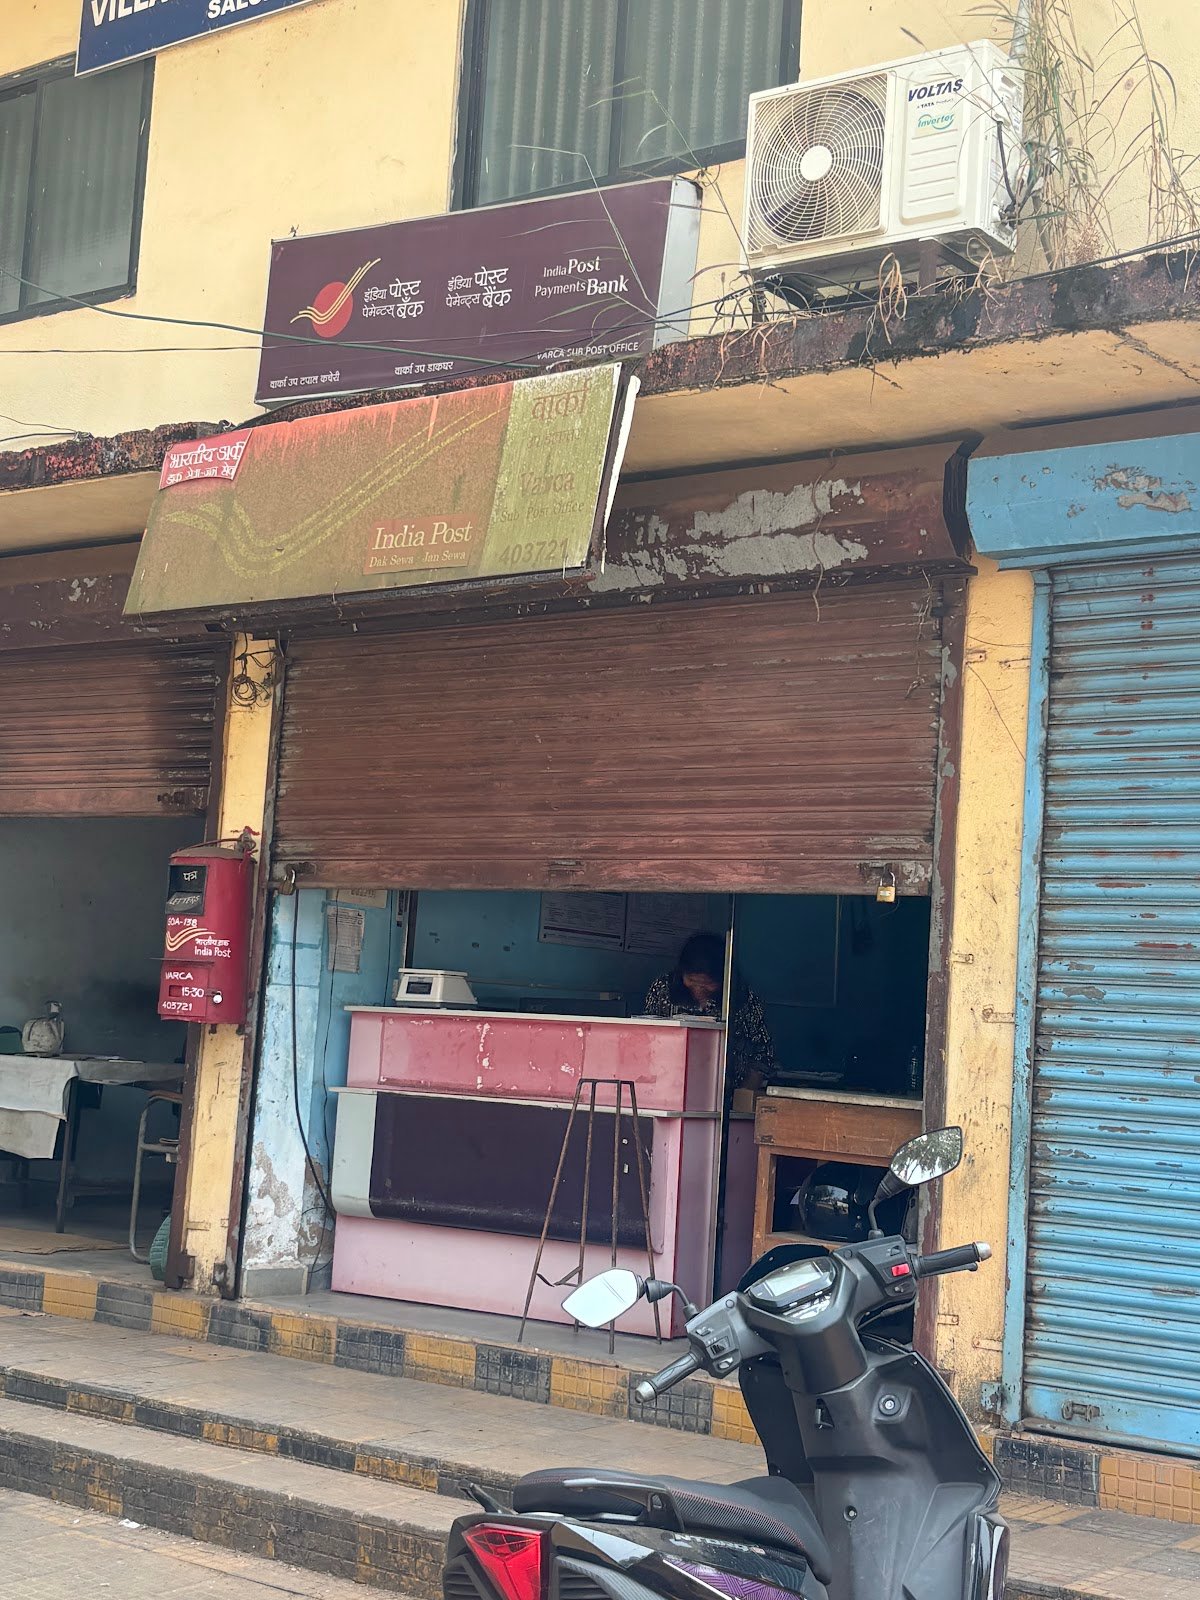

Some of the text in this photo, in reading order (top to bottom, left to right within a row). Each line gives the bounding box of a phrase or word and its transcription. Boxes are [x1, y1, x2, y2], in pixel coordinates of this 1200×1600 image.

[91, 0, 168, 27] VILL
[207, 0, 267, 19] SAL
[908, 78, 964, 102] VOLTAS
[543, 255, 601, 278] India Post
[364, 278, 421, 302] इंडिया पोस्ट
[447, 266, 509, 292] इंडिया पोस्ट
[534, 275, 629, 298] Payments Bank
[396, 296, 425, 318] बँक
[482, 286, 513, 308] बैंक
[537, 349, 564, 360] VARCA
[585, 344, 608, 355] POST
[609, 342, 639, 353] OFFICE
[170, 443, 218, 469] भारतीय
[526, 505, 549, 520] Post
[553, 500, 585, 515] Office
[371, 521, 473, 550] India Post
[369, 550, 466, 568] Dak Sewa Jan Sewa
[499, 538, 569, 565] 403721
[183, 870, 198, 881] पत्र
[195, 946, 232, 958] India Post
[165, 971, 194, 980] VARCA
[162, 1000, 193, 1011] 403721
